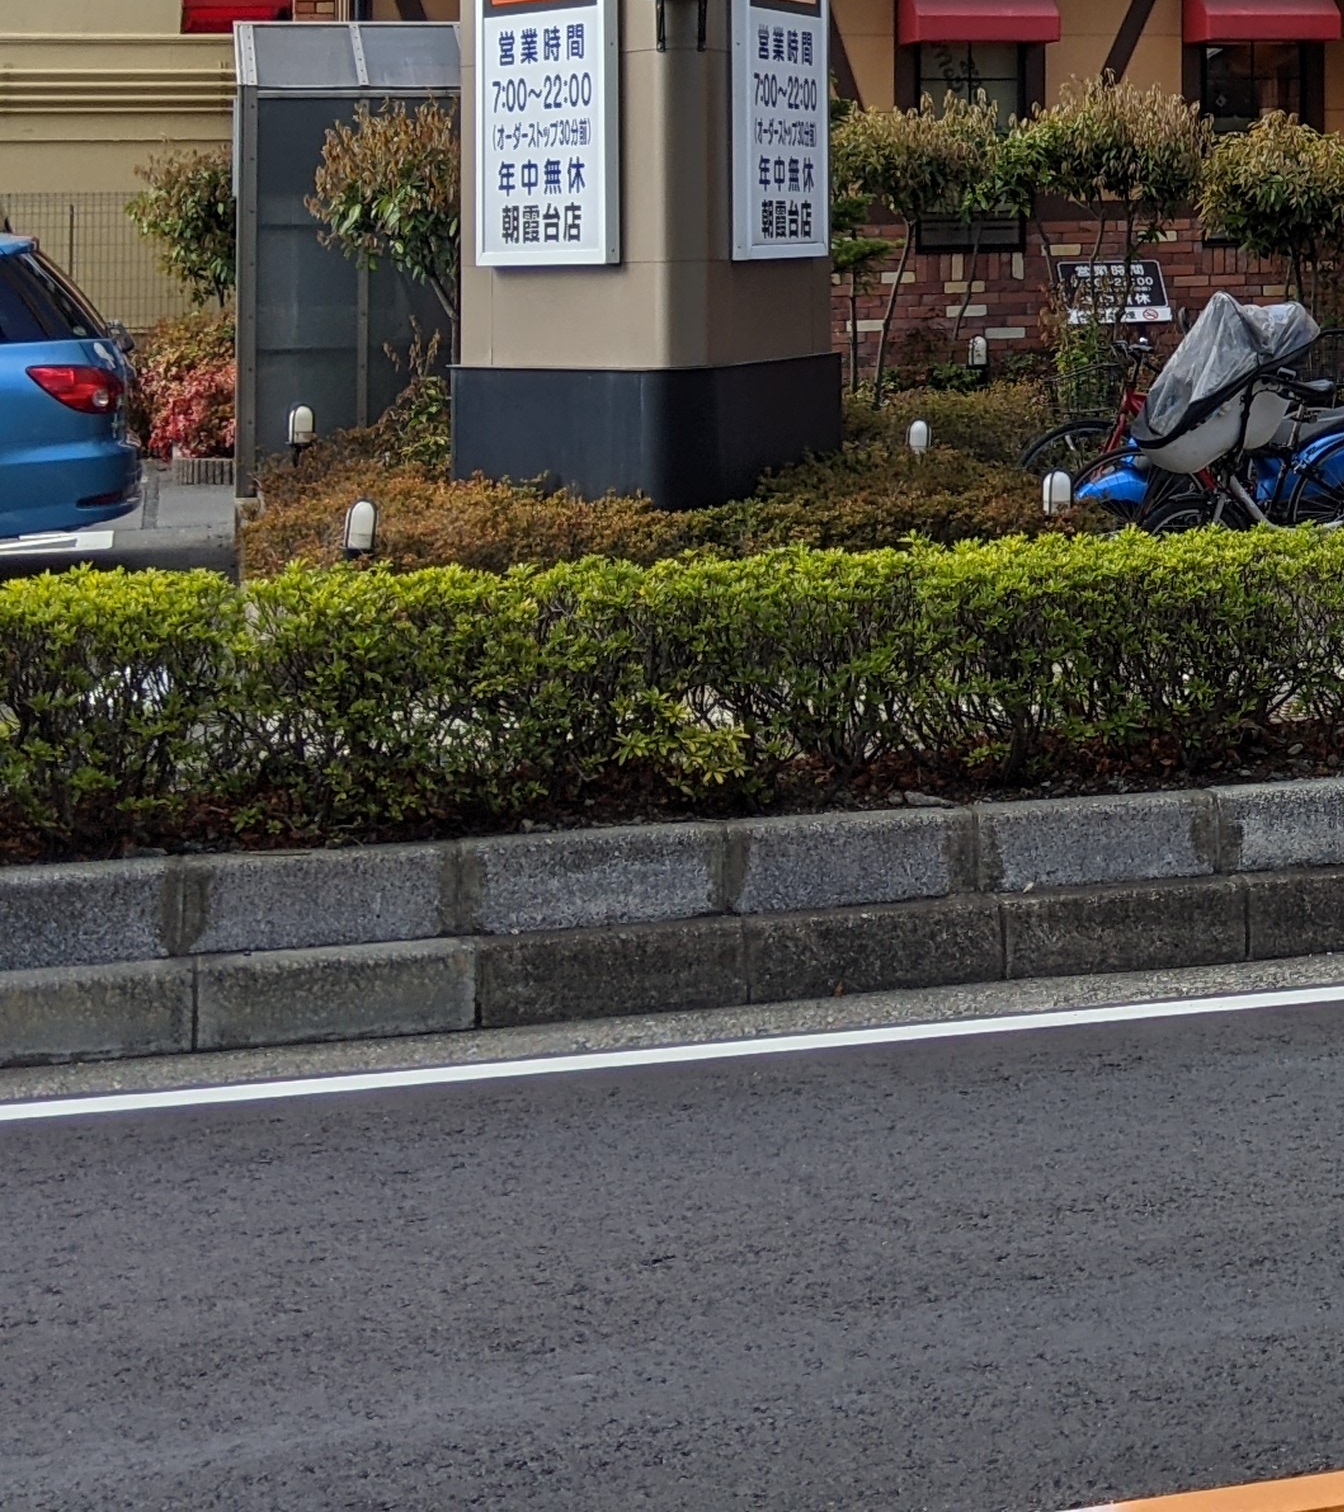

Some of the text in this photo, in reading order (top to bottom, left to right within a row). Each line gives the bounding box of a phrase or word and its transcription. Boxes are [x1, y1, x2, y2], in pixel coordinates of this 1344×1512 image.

[498, 23, 585, 67] 営業時間
[756, 24, 814, 67] 営業時間
[497, 155, 586, 197] 年中無休
[757, 155, 815, 192] 年中無休
[500, 201, 583, 245] 朝霞台店
[760, 199, 813, 239] 朝霞台店
